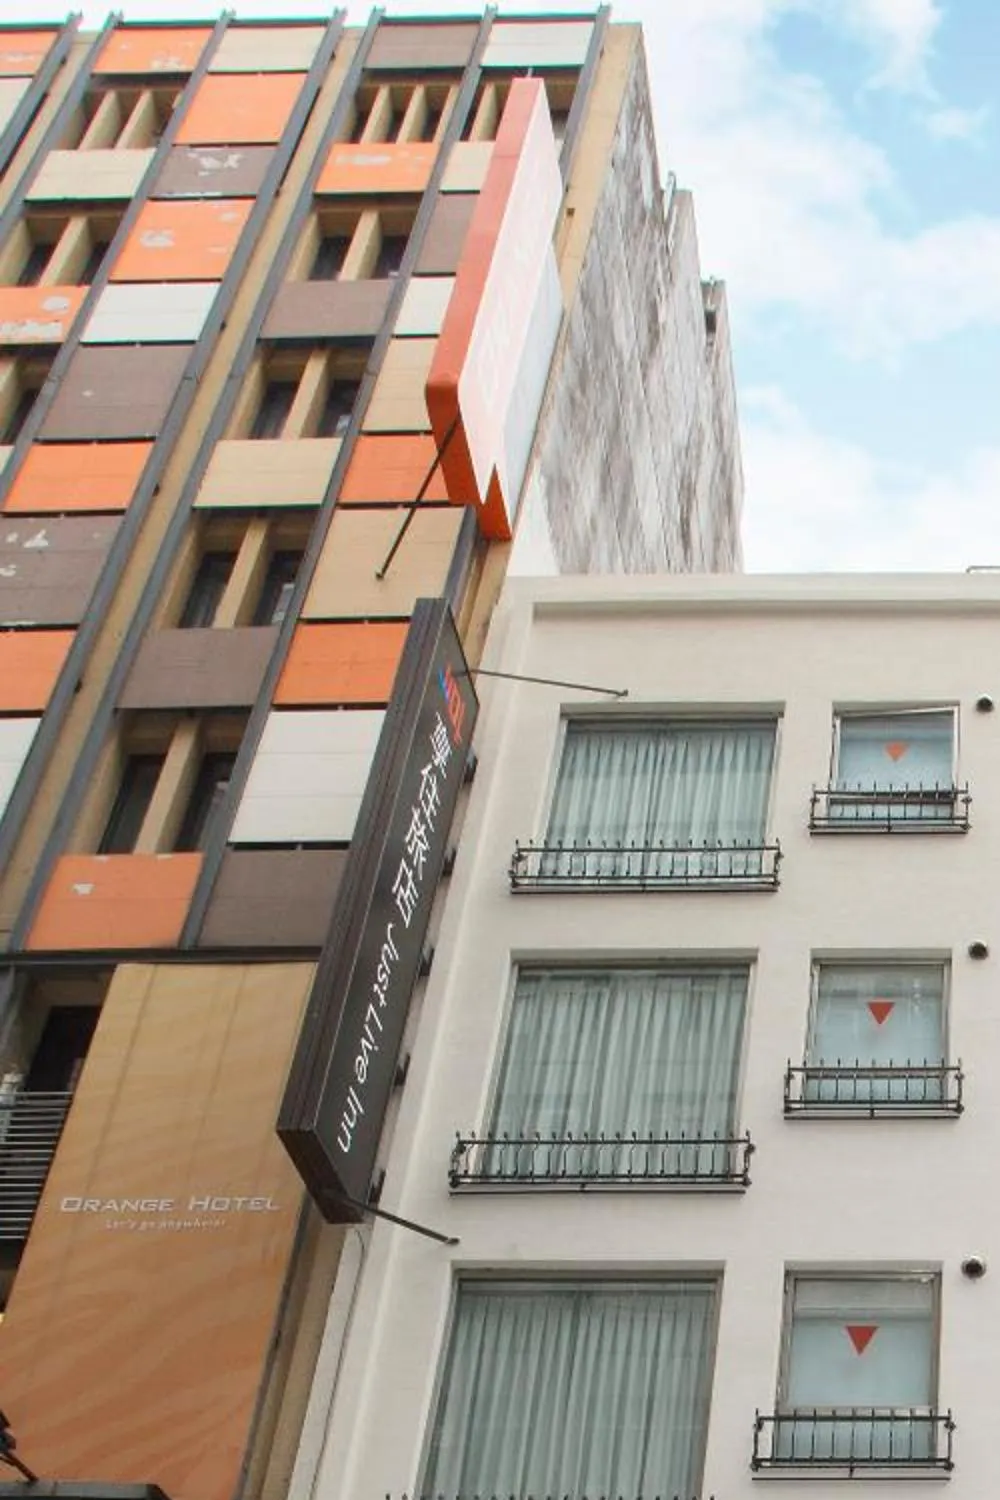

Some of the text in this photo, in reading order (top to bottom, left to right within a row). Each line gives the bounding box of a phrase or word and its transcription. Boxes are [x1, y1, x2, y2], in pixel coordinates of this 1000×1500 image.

[336, 922, 400, 1154] Just Live Inn
[60, 1195, 282, 1213] ORANGE HOTEL
